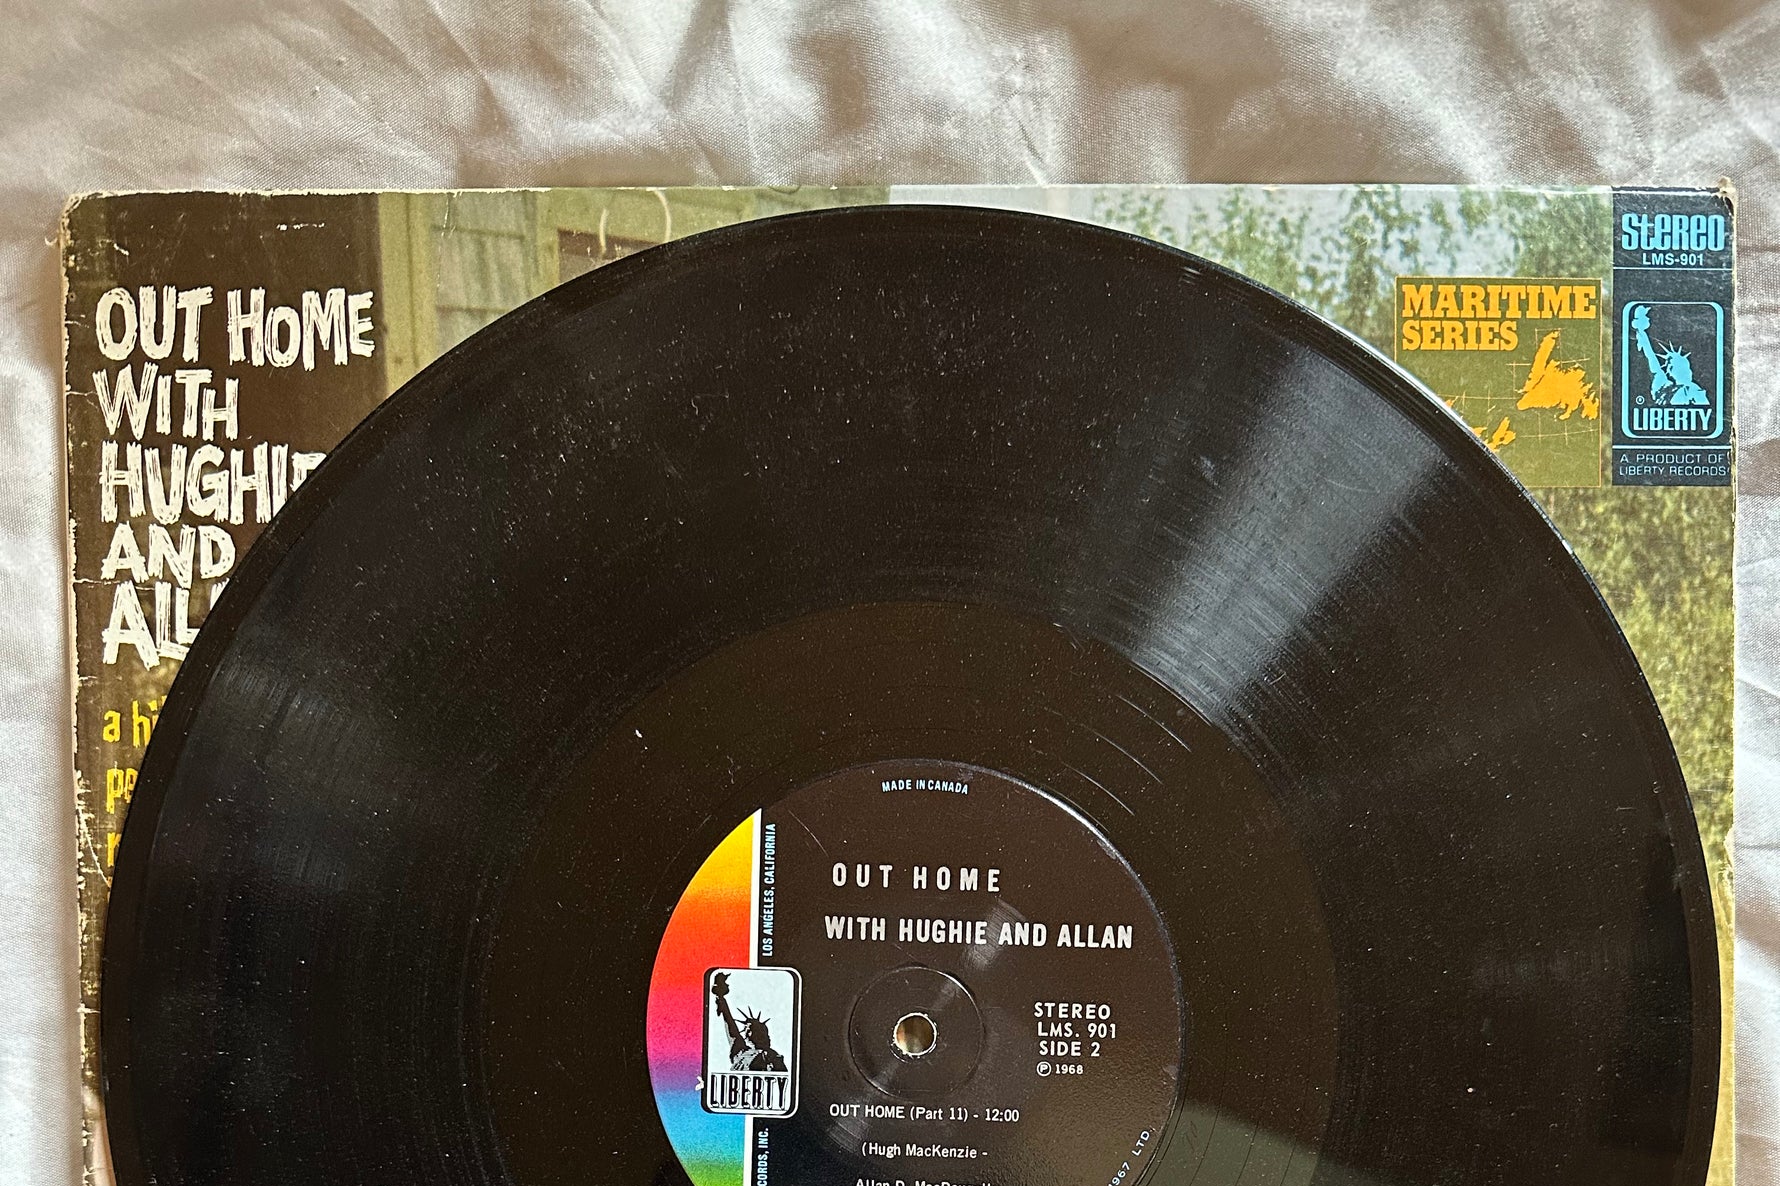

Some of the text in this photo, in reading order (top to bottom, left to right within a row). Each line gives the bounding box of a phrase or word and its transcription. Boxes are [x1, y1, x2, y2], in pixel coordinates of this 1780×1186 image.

[1642, 253, 1704, 266] LMS-901
[1402, 284, 1597, 320] MARITIME
[96, 285, 376, 371] OUT HOME
[1402, 320, 1519, 351] SERIES
[92, 362, 239, 441] WITH
[1633, 408, 1713, 431] LIBERTY
[1620, 453, 1725, 464] A PRODUCT OF
[1619, 466, 1727, 476] LIBERTY RECORDS
[101, 520, 236, 589] AND
[102, 710, 121, 743] a
[881, 779, 969, 795] MADE IN CANADA
[764, 823, 776, 884] CALIFORNIA
[832, 862, 1001, 893] OUT HOME
[825, 915, 1133, 949] WITH HUGHIE AND ALLAN
[762, 938, 773, 957] LOS
[1034, 1002, 1111, 1020] STEREO
[1037, 1021, 1116, 1039] LMS. 901
[1039, 1040, 1101, 1057] SIDE 2
[1055, 1063, 1084, 1075] 1968
[710, 1074, 789, 1110] LIBERTY
[829, 1103, 861, 1117] OUT
[864, 1104, 906, 1119] HOME
[910, 1106, 943, 1121] (Part
[985, 1108, 1020, 1122] 12:00
[758, 1128, 769, 1149] INC.
[862, 1142, 901, 1159] (Hugh
[905, 1143, 978, 1158] MacKenzie
